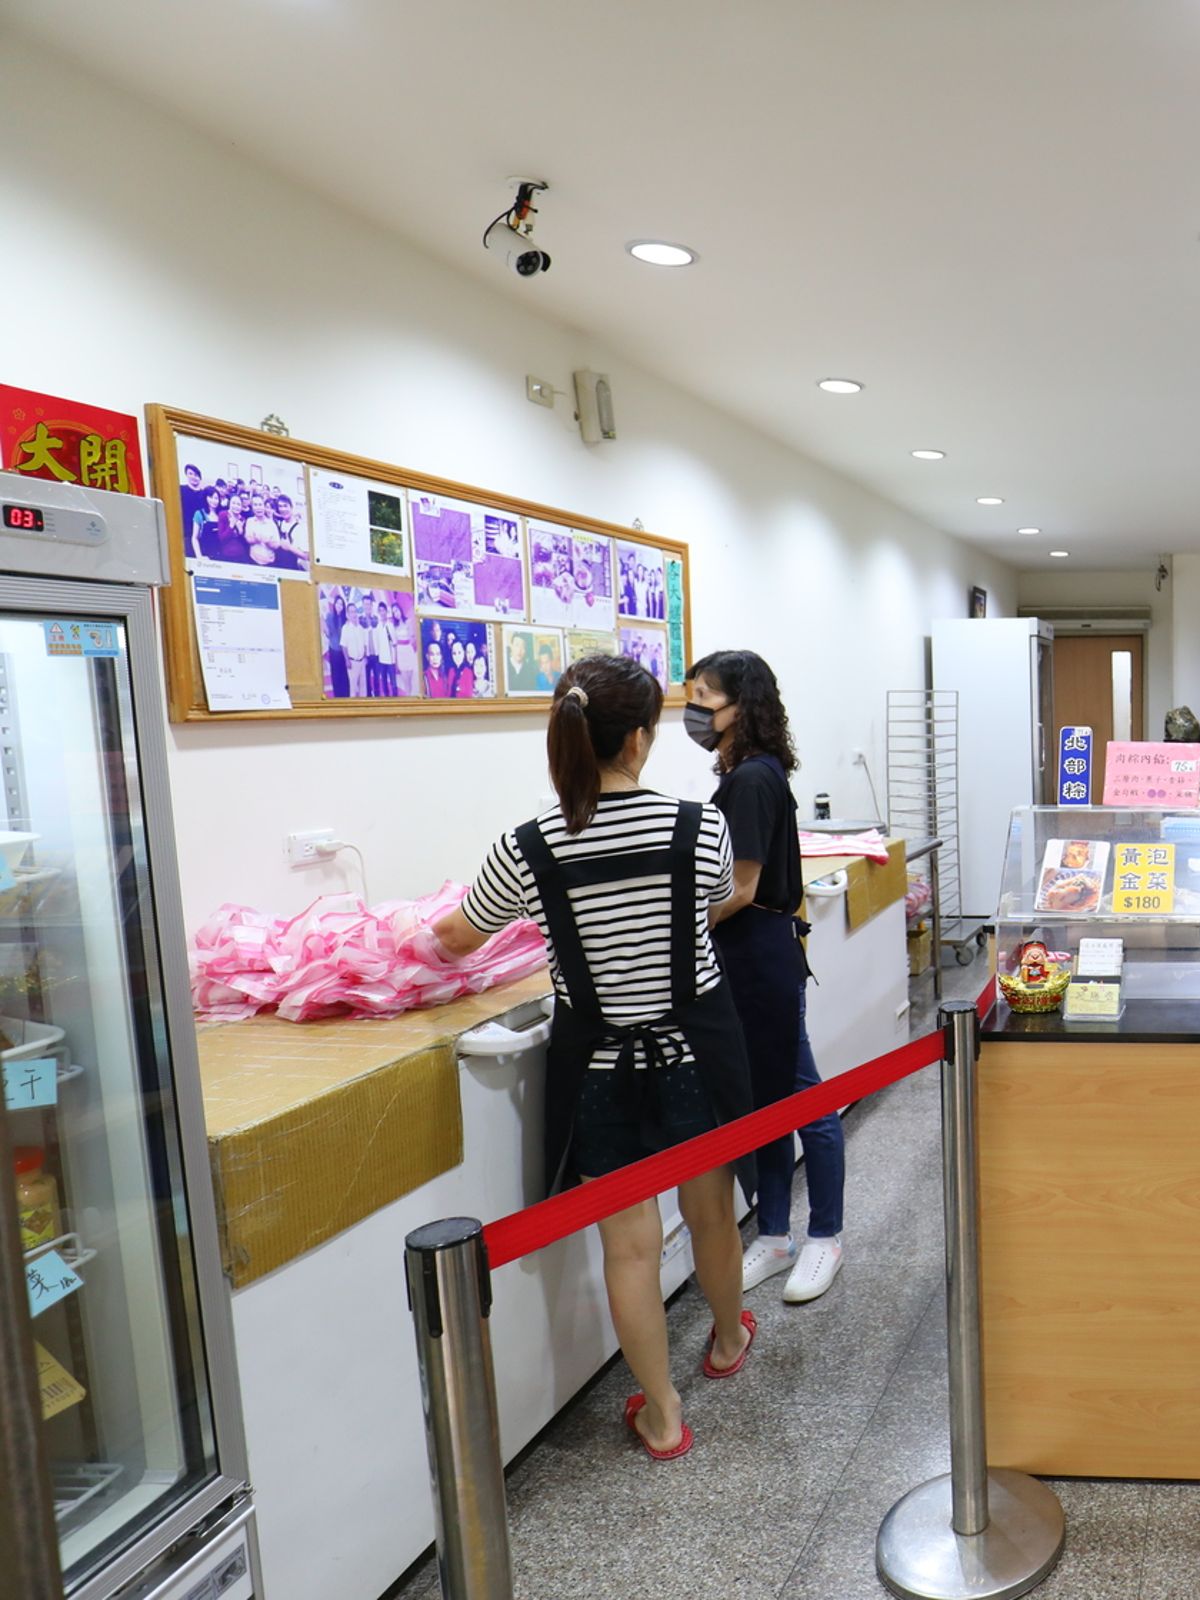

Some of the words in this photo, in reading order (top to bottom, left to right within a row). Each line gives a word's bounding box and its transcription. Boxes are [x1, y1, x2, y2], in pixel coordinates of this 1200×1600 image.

[10, 508, 35, 529] 03
[1064, 735, 1088, 799] 北部粽
[1123, 896, 1161, 910] $180
